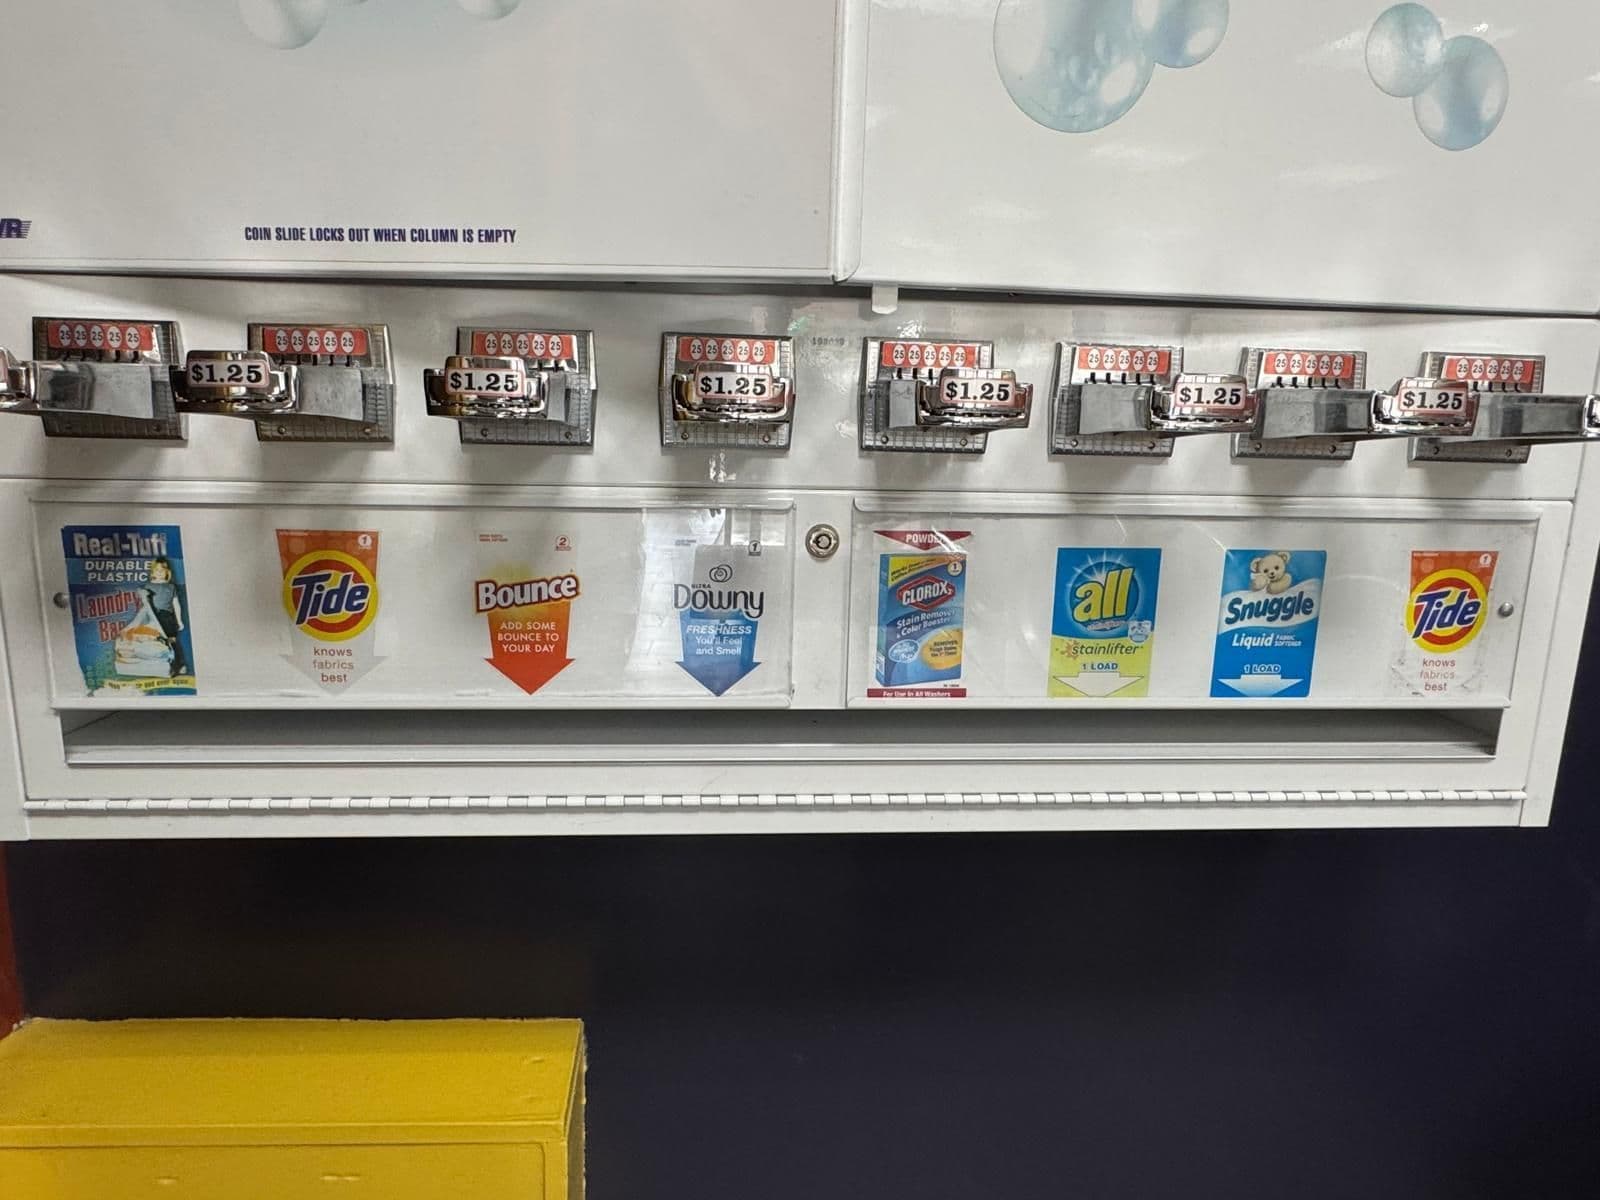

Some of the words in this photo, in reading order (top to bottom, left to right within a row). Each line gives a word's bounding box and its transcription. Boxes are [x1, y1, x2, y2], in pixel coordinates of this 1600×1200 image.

[244, 226, 272, 241] COIN
[275, 227, 306, 242] SLIDE
[309, 227, 345, 242] LOCKS
[348, 228, 370, 243] OUT
[373, 228, 407, 243] WHEN
[410, 228, 459, 244] COLUMN
[462, 229, 475, 244] IS
[478, 229, 517, 244] EMPTY
[60, 330, 70, 340] 25
[75, 331, 87, 341] 25
[92, 331, 103, 341] 25
[109, 331, 121, 342] 25
[127, 332, 139, 343] 25
[277, 335, 288, 345] 25
[292, 335, 303, 346] 25
[308, 335, 319, 346] 25
[325, 336, 337, 347] 25
[342, 336, 354, 347] 25
[486, 338, 497, 349] 25
[502, 339, 513, 350] 25
[518, 339, 529, 350] 25
[533, 339, 545, 350] 25
[550, 340, 561, 351] 25
[691, 344, 702, 354] 25
[707, 344, 718, 354] 25
[722, 344, 733, 355] 25
[738, 345, 749, 355] 25
[753, 345, 764, 356] 25
[894, 349, 904, 359] 25
[909, 349, 920, 360] 25
[925, 350, 936, 360] 25
[940, 351, 951, 361] 25
[955, 351, 965, 361] 25
[1088, 353, 1099, 363] 25
[1103, 353, 1115, 364] 25
[1119, 354, 1130, 364] 25
[1134, 355, 1144, 365] 25
[1148, 356, 1159, 366] 25
[1276, 358, 1286, 369] 25
[1291, 358, 1302, 369] 25
[1306, 359, 1317, 369] 25
[1320, 360, 1330, 370] 25
[1333, 361, 1343, 371] 25
[1457, 363, 1468, 373] 25
[1472, 364, 1484, 374] 25
[1488, 364, 1499, 374] 25
[1501, 365, 1511, 375] 25
[1513, 365, 1524, 376] 25
[191, 363, 263, 384] $1.25
[449, 372, 519, 393] $1.25
[700, 374, 767, 396] $1.25
[945, 381, 1010, 401] $1.25
[1179, 386, 1242, 406] $1.25
[1402, 390, 1463, 410] $1.25
[73, 532, 167, 557] Real-Tuff
[906, 533, 947, 544] POWD
[85, 560, 151, 571] DURABLE
[87, 572, 149, 582] PLASTIC
[292, 572, 370, 626] Tide
[477, 575, 579, 613] Bounce
[1072, 567, 1135, 623] all
[76, 590, 143, 619] Laundry
[673, 584, 764, 619] Downy
[1225, 591, 1314, 625] Snuggle
[1412, 589, 1482, 639] Tide
[500, 621, 523, 631] ADD
[527, 621, 557, 631] SOME
[896, 615, 920, 629] Stain
[686, 624, 752, 634] FRESHNESS
[901, 624, 922, 636] Color
[497, 632, 541, 642] BOUNCE
[544, 632, 559, 642] TO
[1231, 632, 1275, 650] Liquid
[313, 646, 353, 657] knows
[502, 644, 531, 653] YOUR
[534, 644, 555, 653] DAY
[696, 646, 713, 655] and
[716, 646, 741, 655] Smell
[1072, 642, 1139, 656] stainlifter
[312, 659, 354, 670] fabrics
[1244, 664, 1250, 673] 1
[1252, 664, 1281, 674] LOAD
[1422, 658, 1456, 667] knows
[321, 672, 347, 683] best
[1420, 670, 1455, 680] fabrics
[1424, 682, 1447, 691] best
